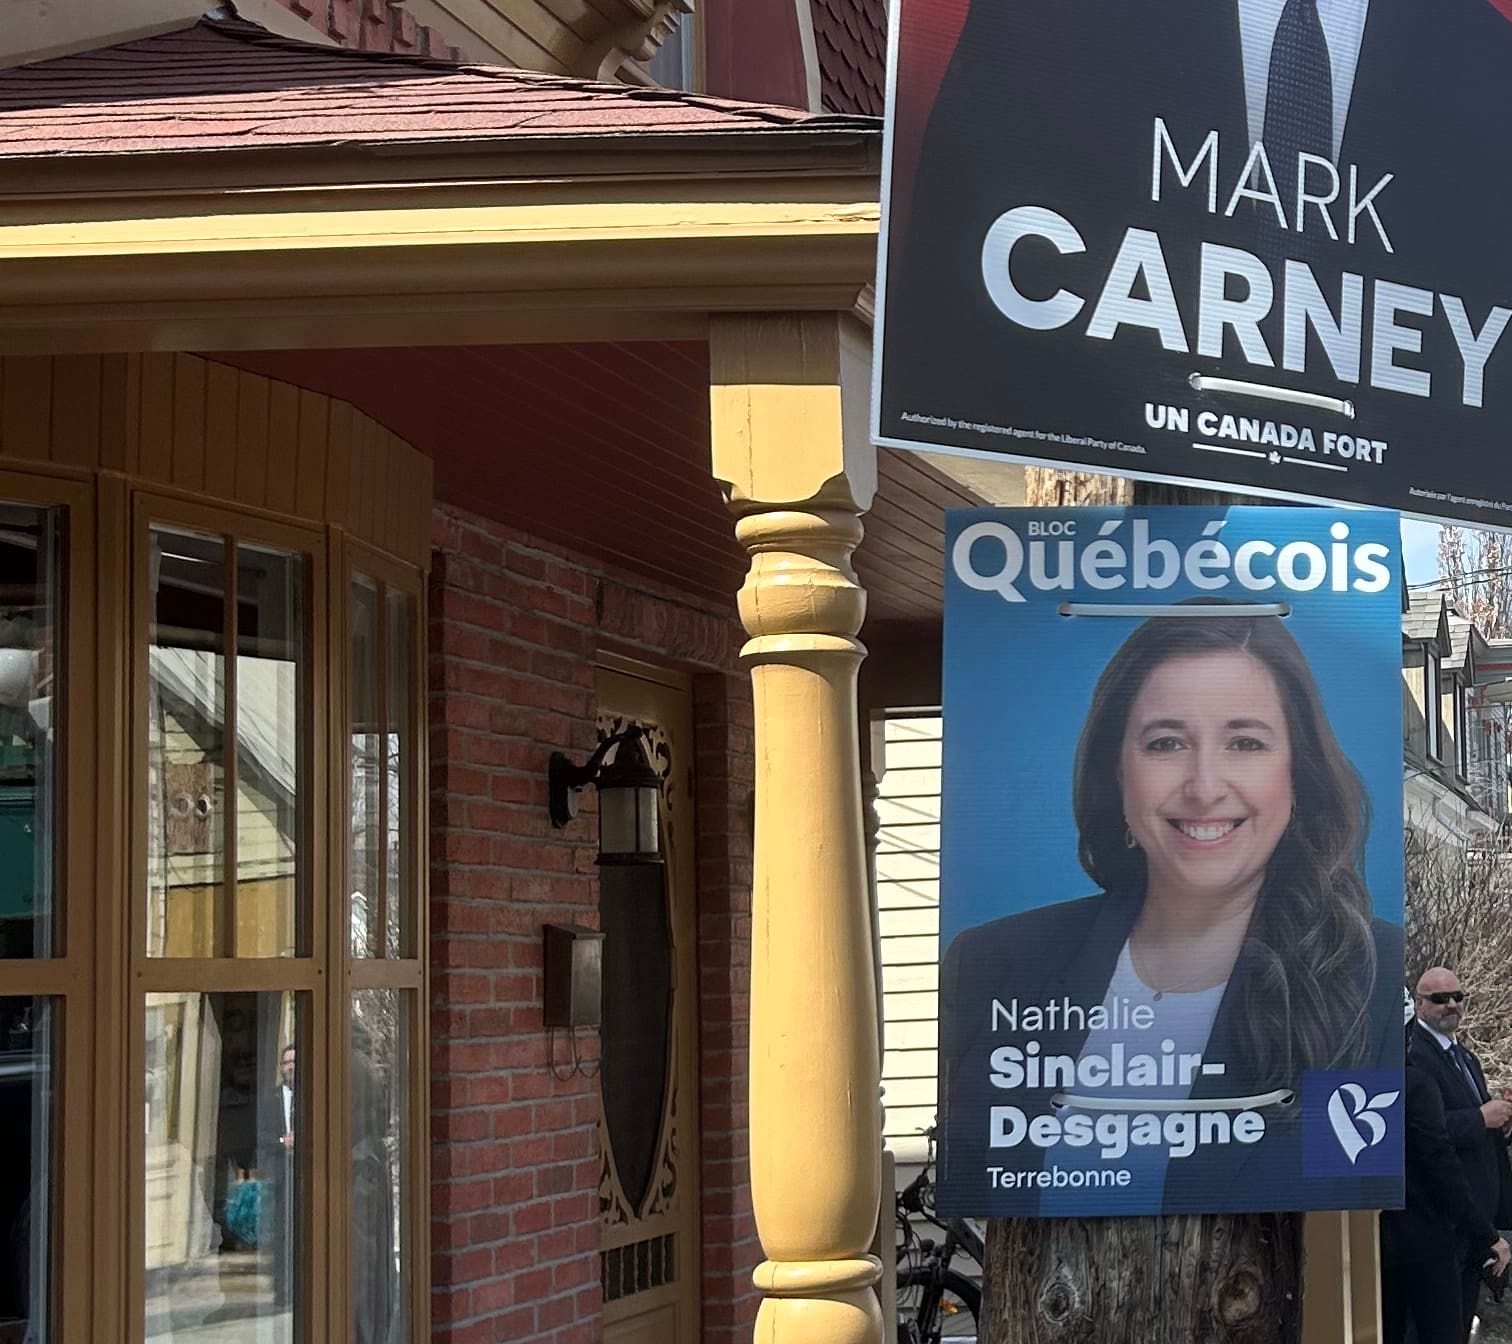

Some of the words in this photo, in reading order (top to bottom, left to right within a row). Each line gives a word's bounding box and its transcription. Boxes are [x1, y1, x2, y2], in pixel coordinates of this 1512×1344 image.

[1151, 116, 1394, 254] MARK
[981, 205, 1512, 408] CARNEY
[900, 411, 947, 426] Authorized
[947, 417, 957, 429] by
[958, 420, 972, 430] the
[972, 424, 1012, 435] registered
[1013, 428, 1034, 438] agent
[1035, 430, 1046, 440] for
[1047, 432, 1061, 443] the
[1061, 434, 1087, 445] Liberal
[1087, 438, 1108, 450] Party
[1108, 441, 1117, 450] of
[1144, 402, 1190, 433] UN
[1196, 410, 1317, 453] CANADA
[1322, 431, 1389, 465] FORT
[1027, 520, 1077, 536] BLOC
[951, 520, 1391, 603] Québécois
[991, 996, 1156, 1032] Nathalie
[989, 1038, 1226, 1089] Sinclair-
[986, 1165, 1131, 1189] Terrebonne
